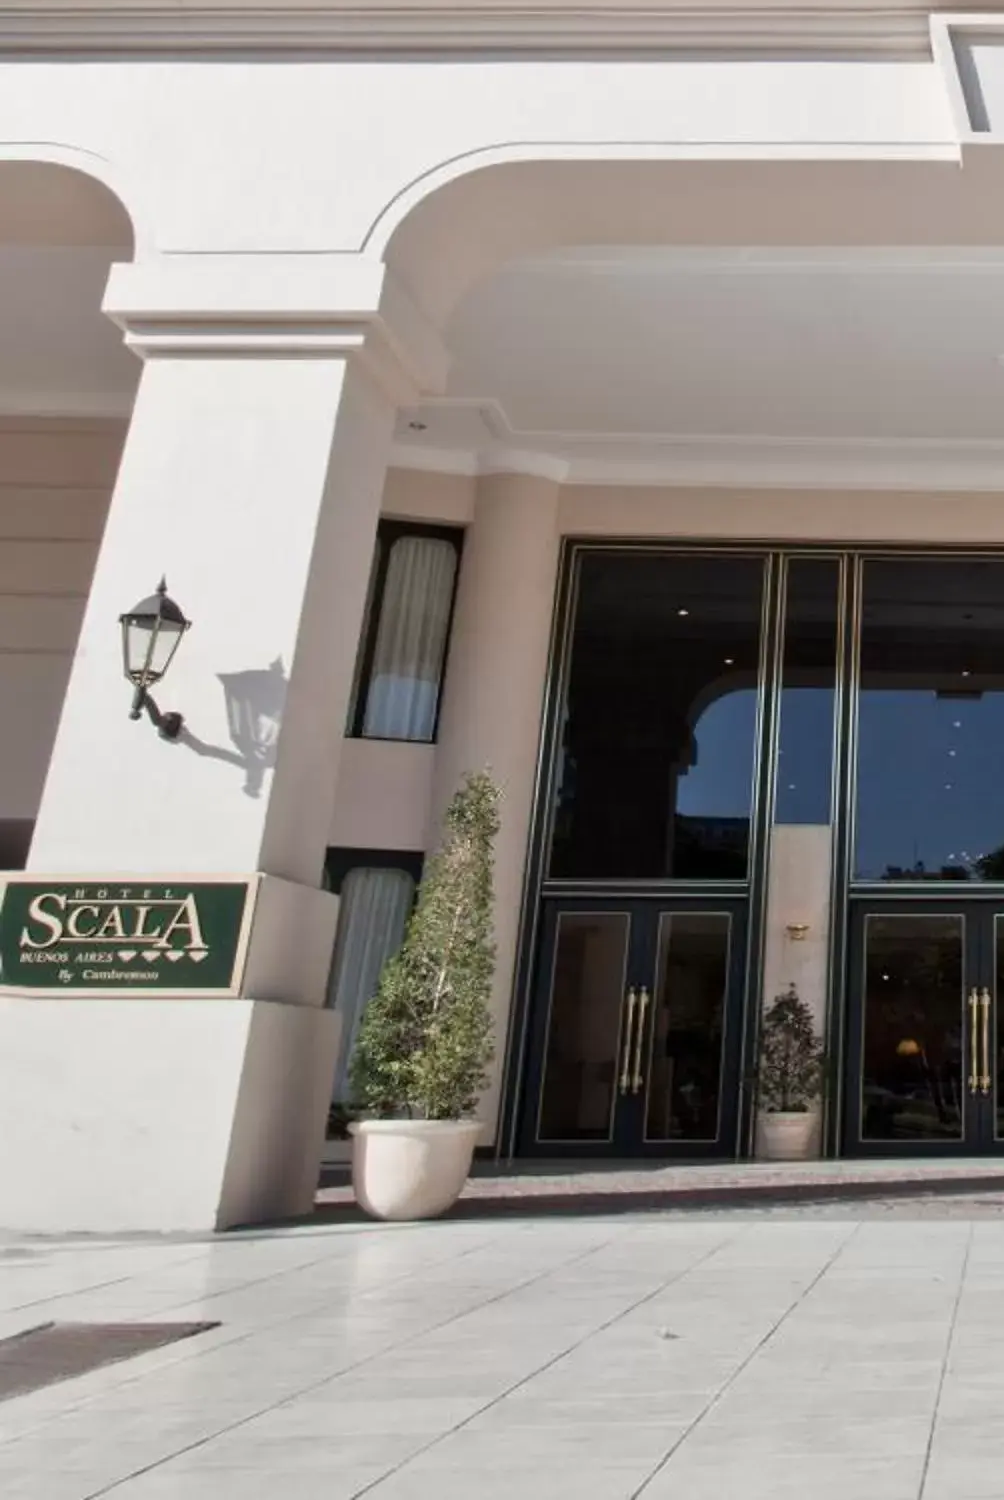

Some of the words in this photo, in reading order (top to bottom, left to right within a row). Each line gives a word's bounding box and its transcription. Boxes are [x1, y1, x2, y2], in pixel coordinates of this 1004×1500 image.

[75, 889, 174, 899] HOTEL
[19, 892, 209, 949] SCALA
[19, 951, 69, 963] BUENOS
[75, 951, 114, 963] AIRES
[58, 969, 74, 983] By
